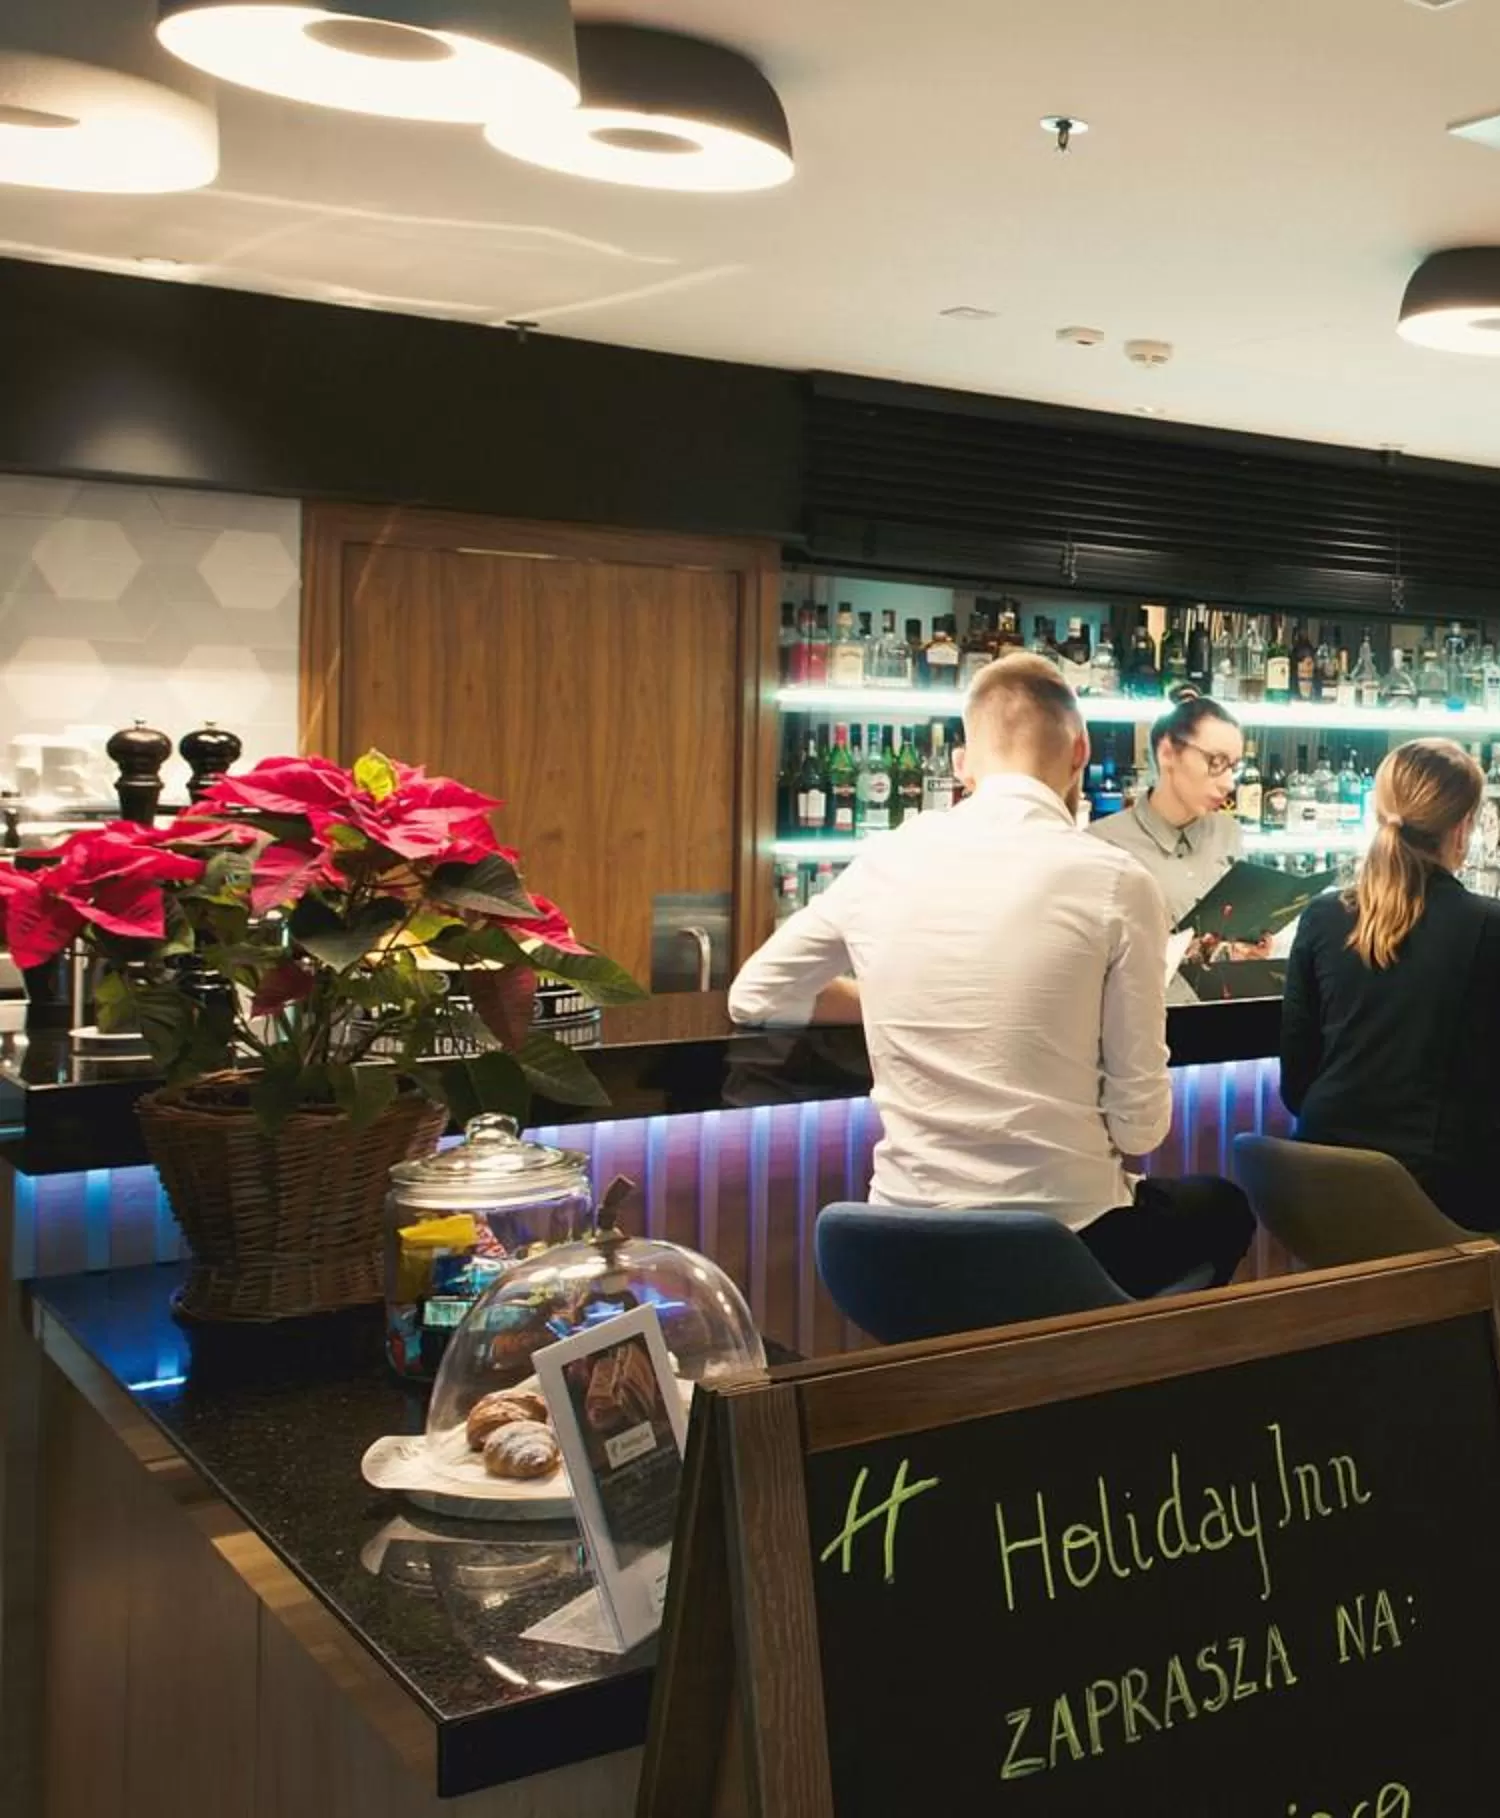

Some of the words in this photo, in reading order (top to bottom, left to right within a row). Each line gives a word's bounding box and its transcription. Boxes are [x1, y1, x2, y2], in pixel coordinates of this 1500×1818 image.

[994, 1452, 1271, 1611] Holiday
[1266, 1423, 1373, 1529] Inn
[1000, 1625, 1299, 1780] ZAPRASZA
[1335, 1588, 1418, 1664] NA:
